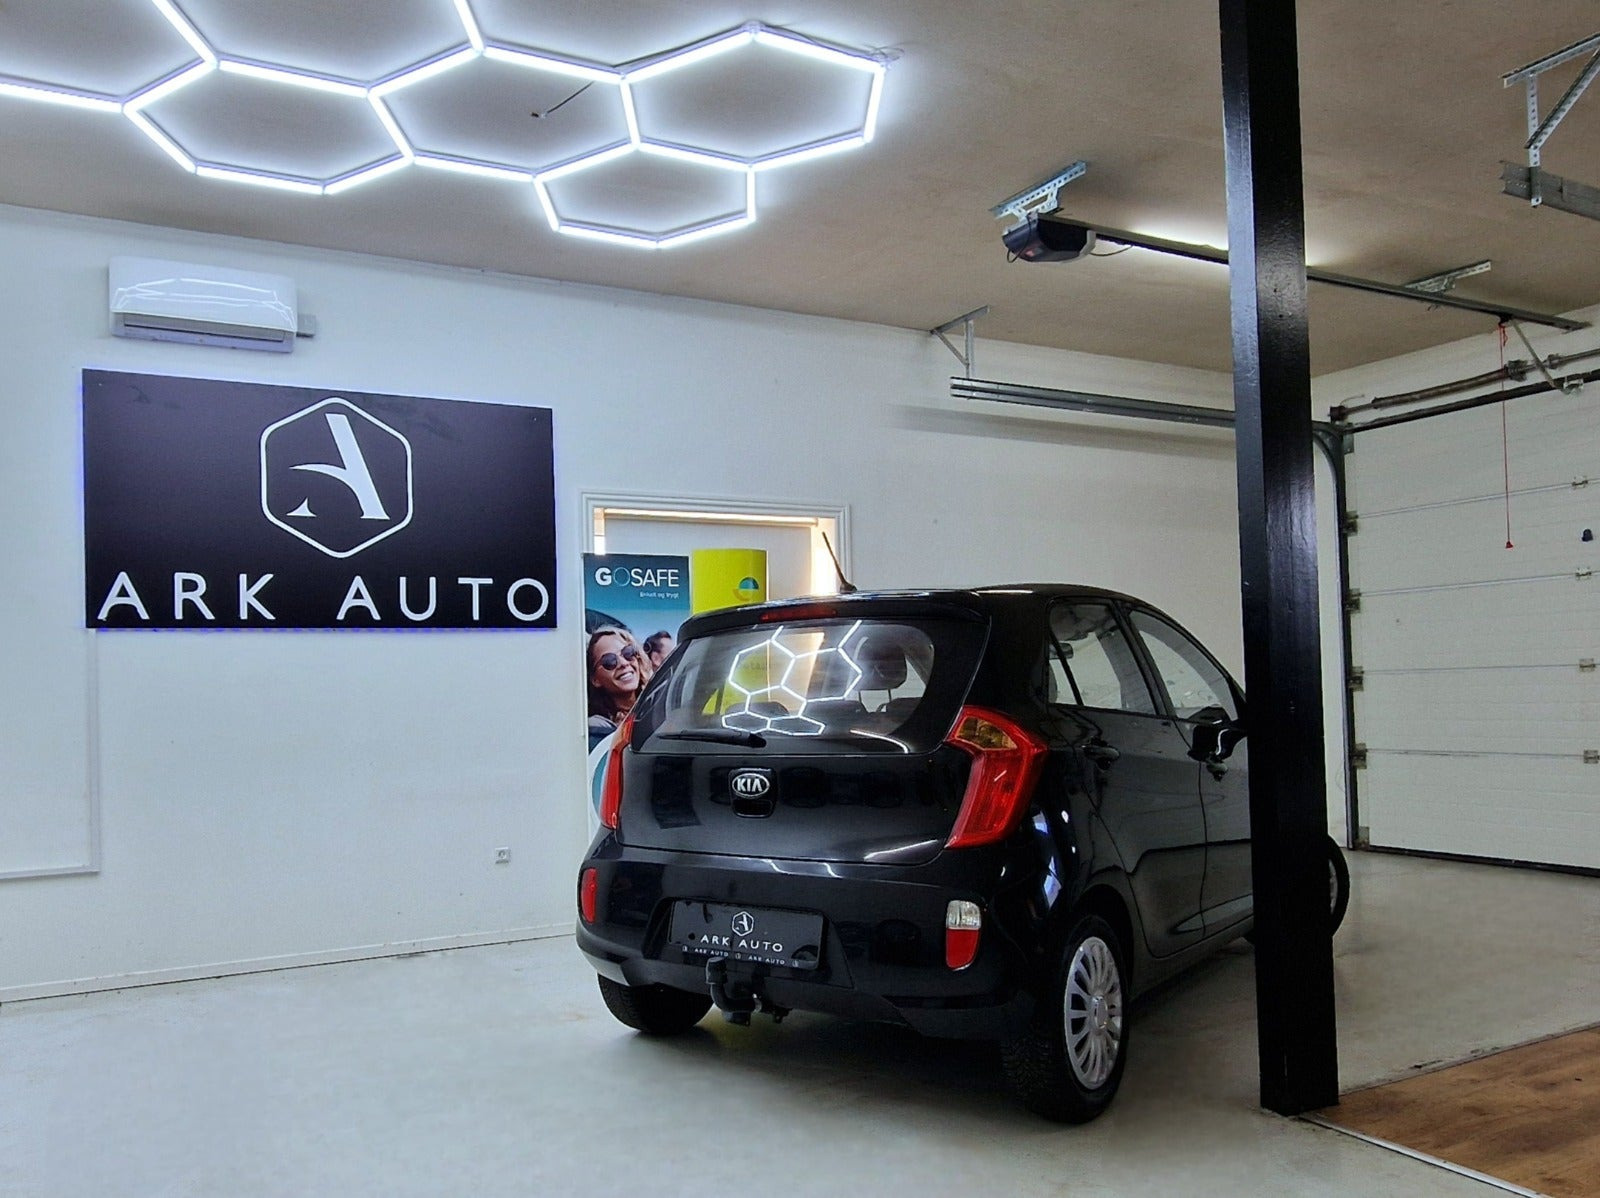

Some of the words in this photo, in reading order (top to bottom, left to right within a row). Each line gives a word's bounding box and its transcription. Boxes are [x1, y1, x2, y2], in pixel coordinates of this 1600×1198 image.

[595, 566, 680, 587] GOSAFE
[97, 571, 276, 621] ARK
[336, 575, 549, 622] AUTO
[737, 777, 763, 792] KIA
[700, 934, 730, 946] ARK
[738, 938, 783, 953] AUTO
